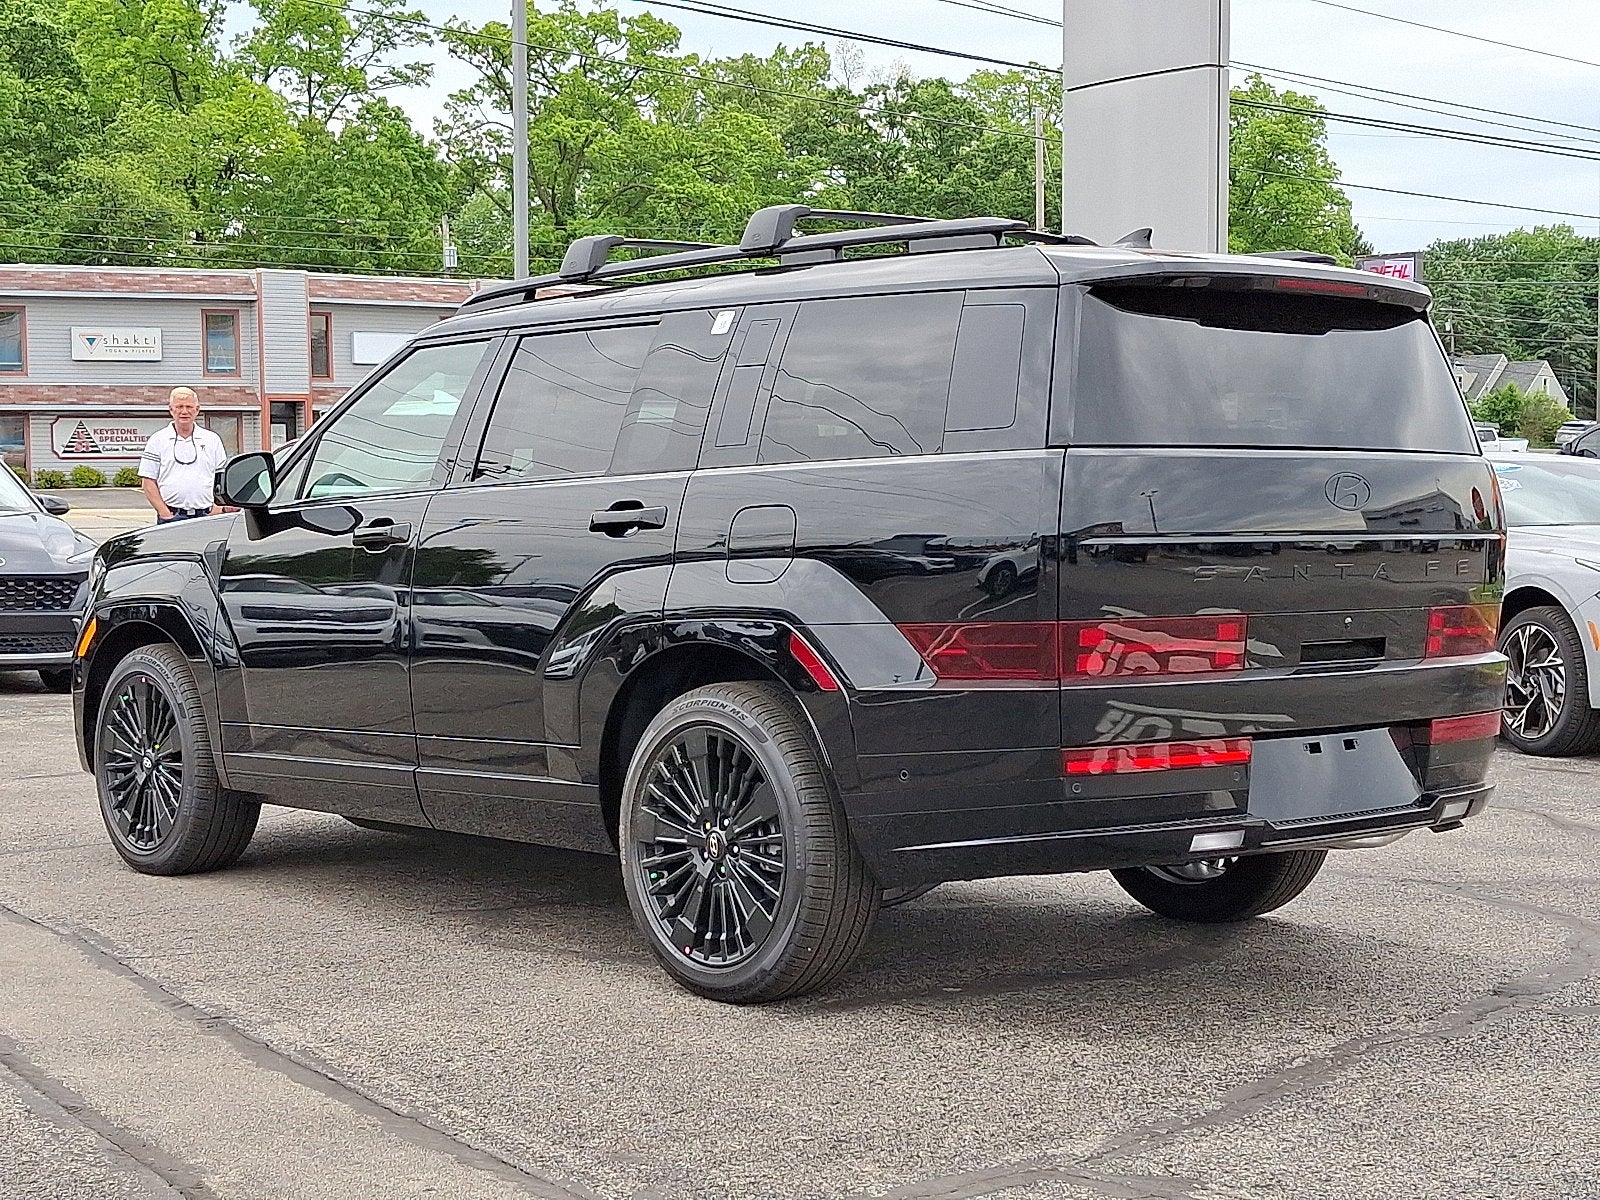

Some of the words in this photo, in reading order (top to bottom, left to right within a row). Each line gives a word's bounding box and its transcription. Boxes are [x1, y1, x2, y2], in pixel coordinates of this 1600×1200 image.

[1369, 264, 1411, 278] DIEHL
[103, 333, 156, 345] shakti
[1193, 562, 1390, 583] SANTA
[1424, 558, 1470, 577] FE
[140, 655, 171, 680] SCORPION
[672, 699, 728, 715] SCORPION
[729, 707, 749, 721] MS
